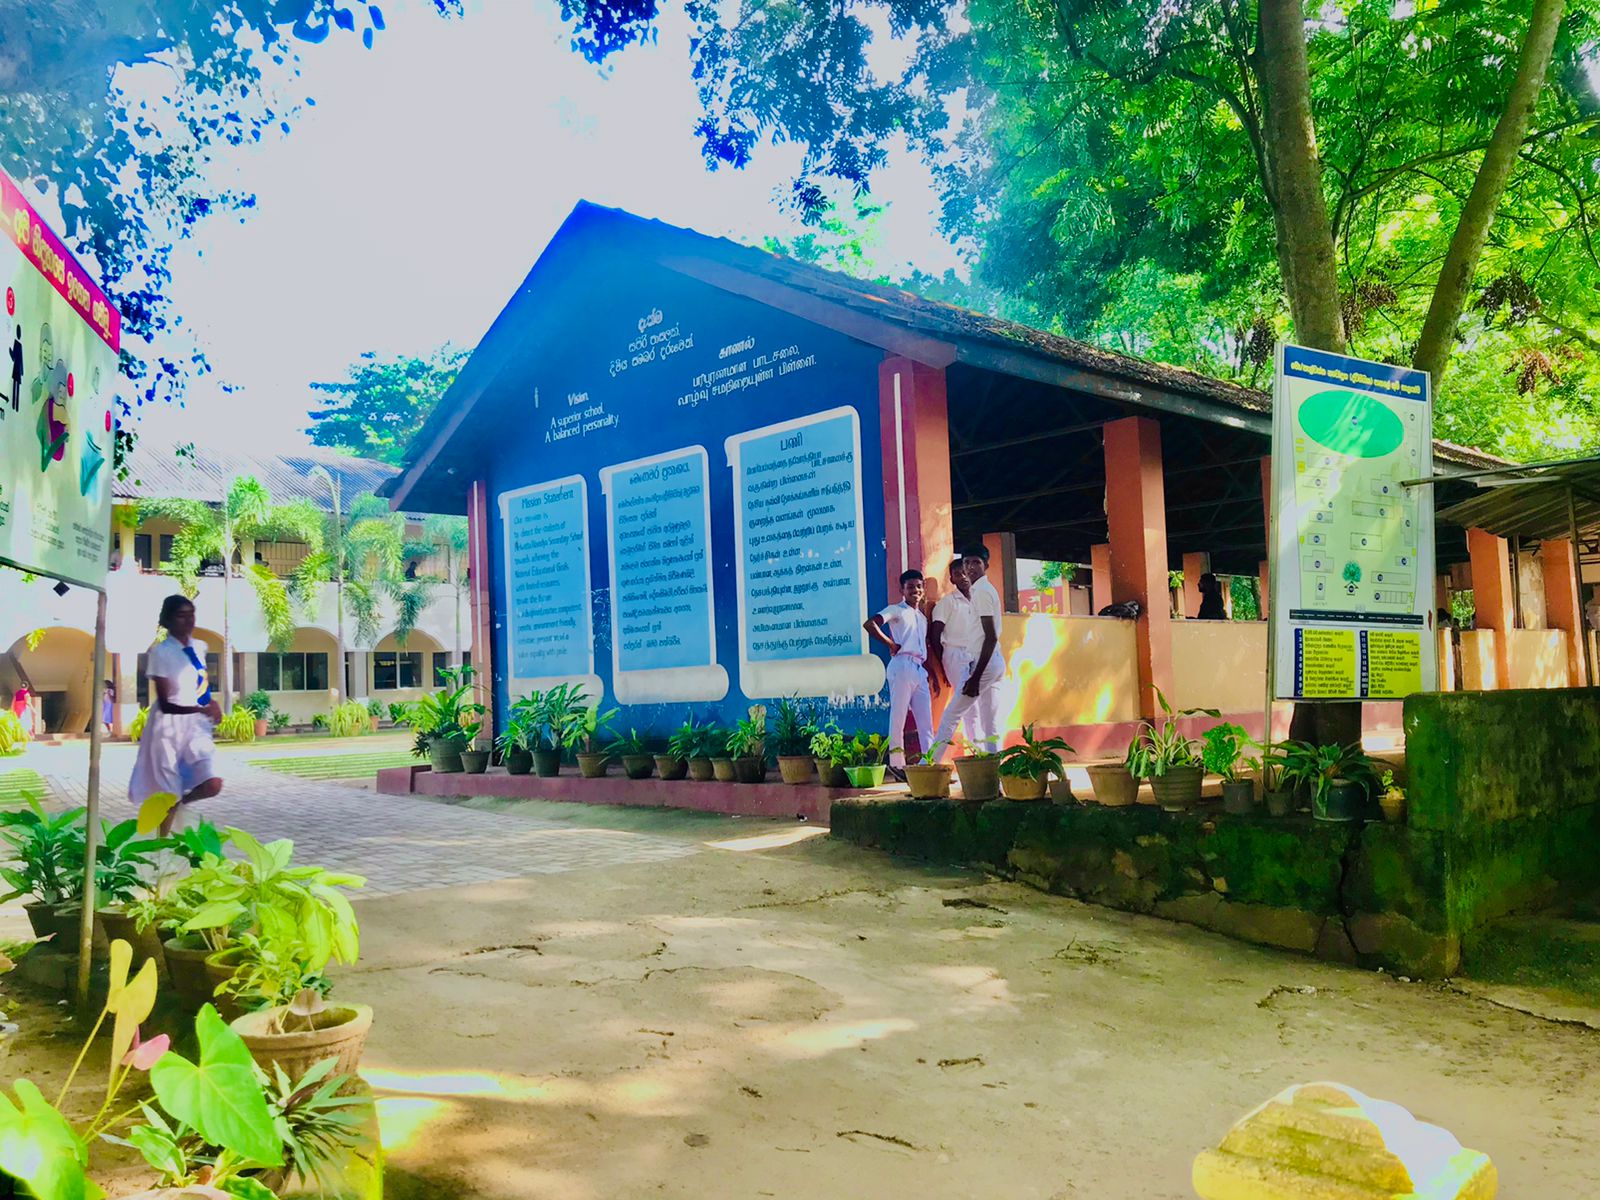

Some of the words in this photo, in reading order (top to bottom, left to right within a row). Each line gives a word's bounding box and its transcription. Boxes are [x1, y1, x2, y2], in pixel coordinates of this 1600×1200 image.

[551, 416, 556, 430] A
[557, 411, 582, 428] superior
[545, 431, 551, 443] A
[553, 422, 580, 441] balanced
[780, 431, 803, 451] பணி
[521, 498, 541, 509] Mission
[543, 490, 574, 504] Statement
